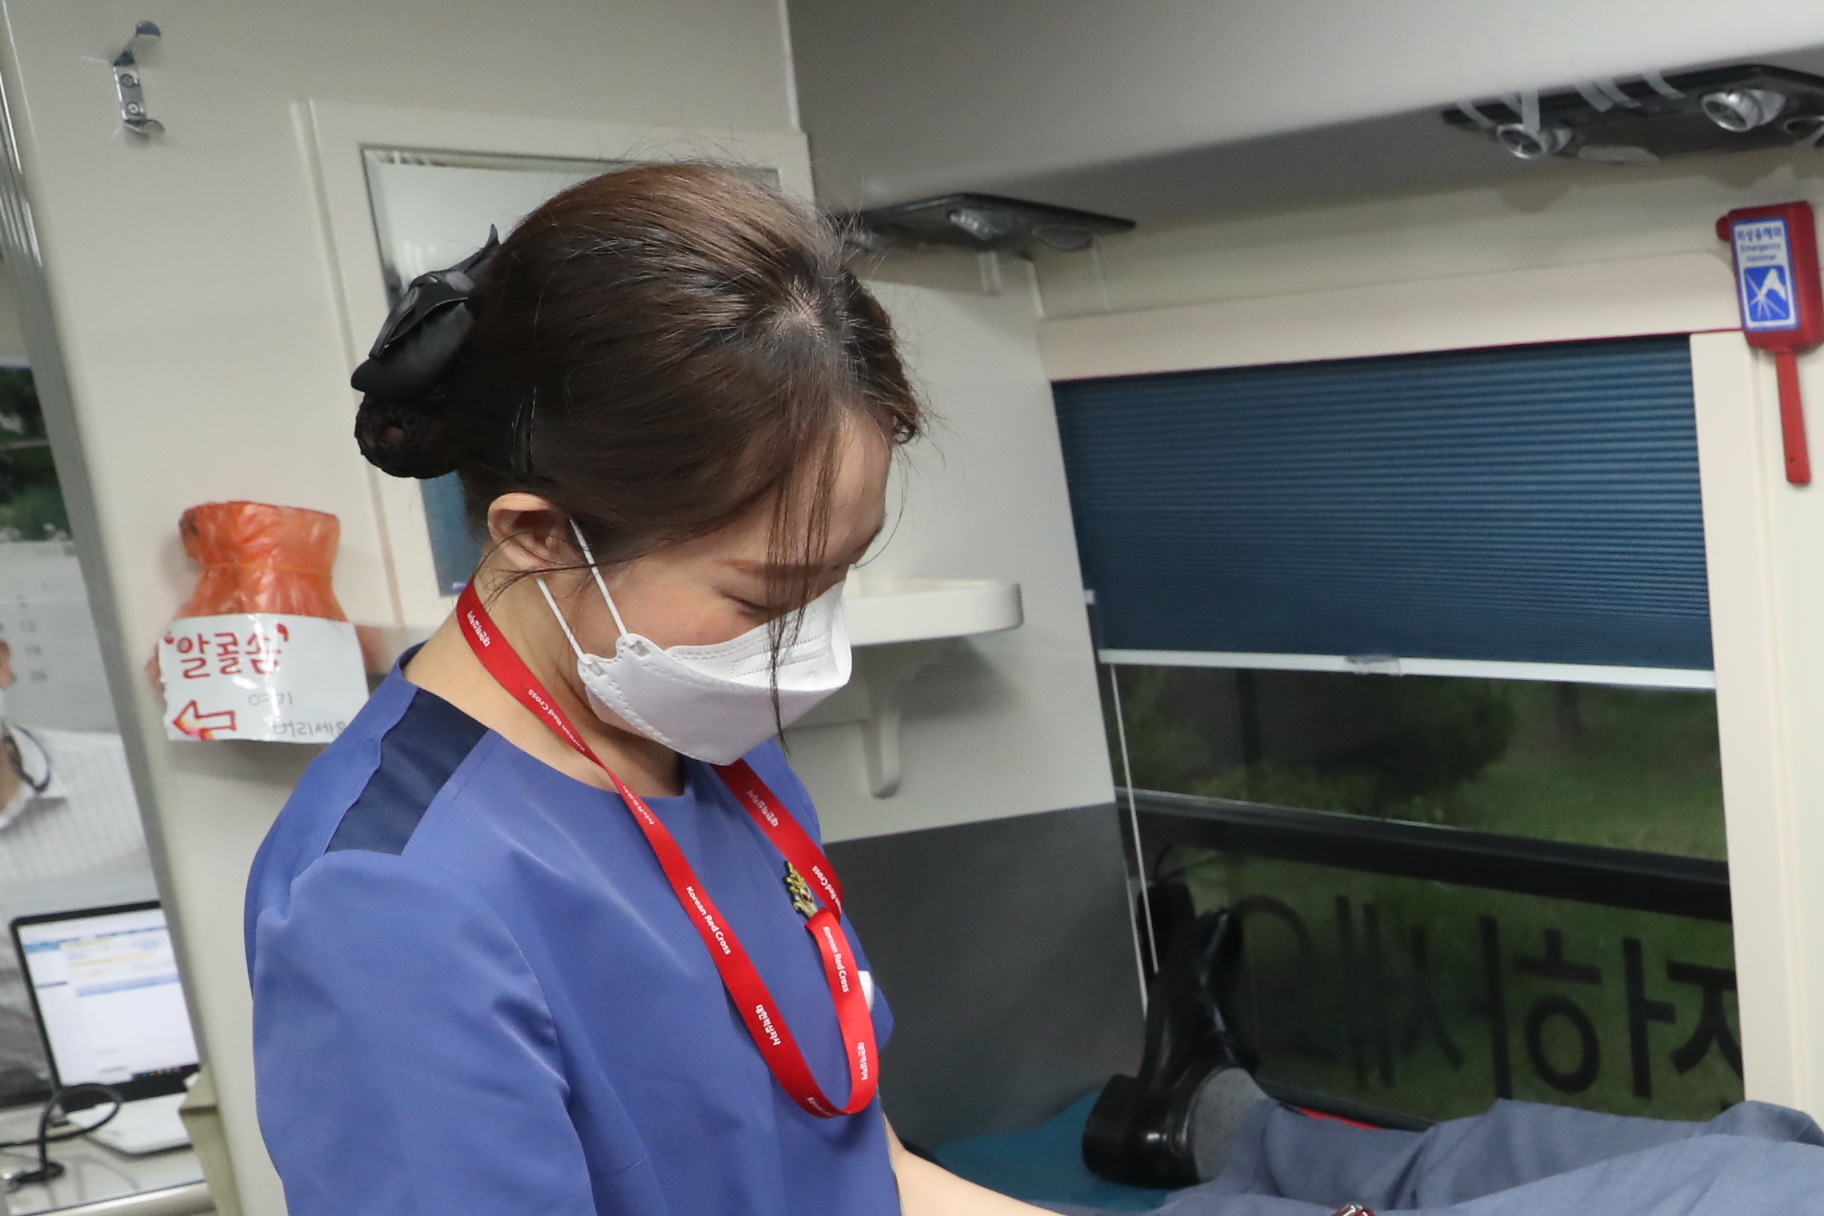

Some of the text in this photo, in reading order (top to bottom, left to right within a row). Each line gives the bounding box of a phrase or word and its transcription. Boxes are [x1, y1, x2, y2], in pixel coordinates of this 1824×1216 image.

[527, 688, 550, 711] Cross
[811, 865, 829, 887] Cross
[685, 885, 732, 956] Korean Red Cross
[822, 926, 850, 993] Korean Red Cross
